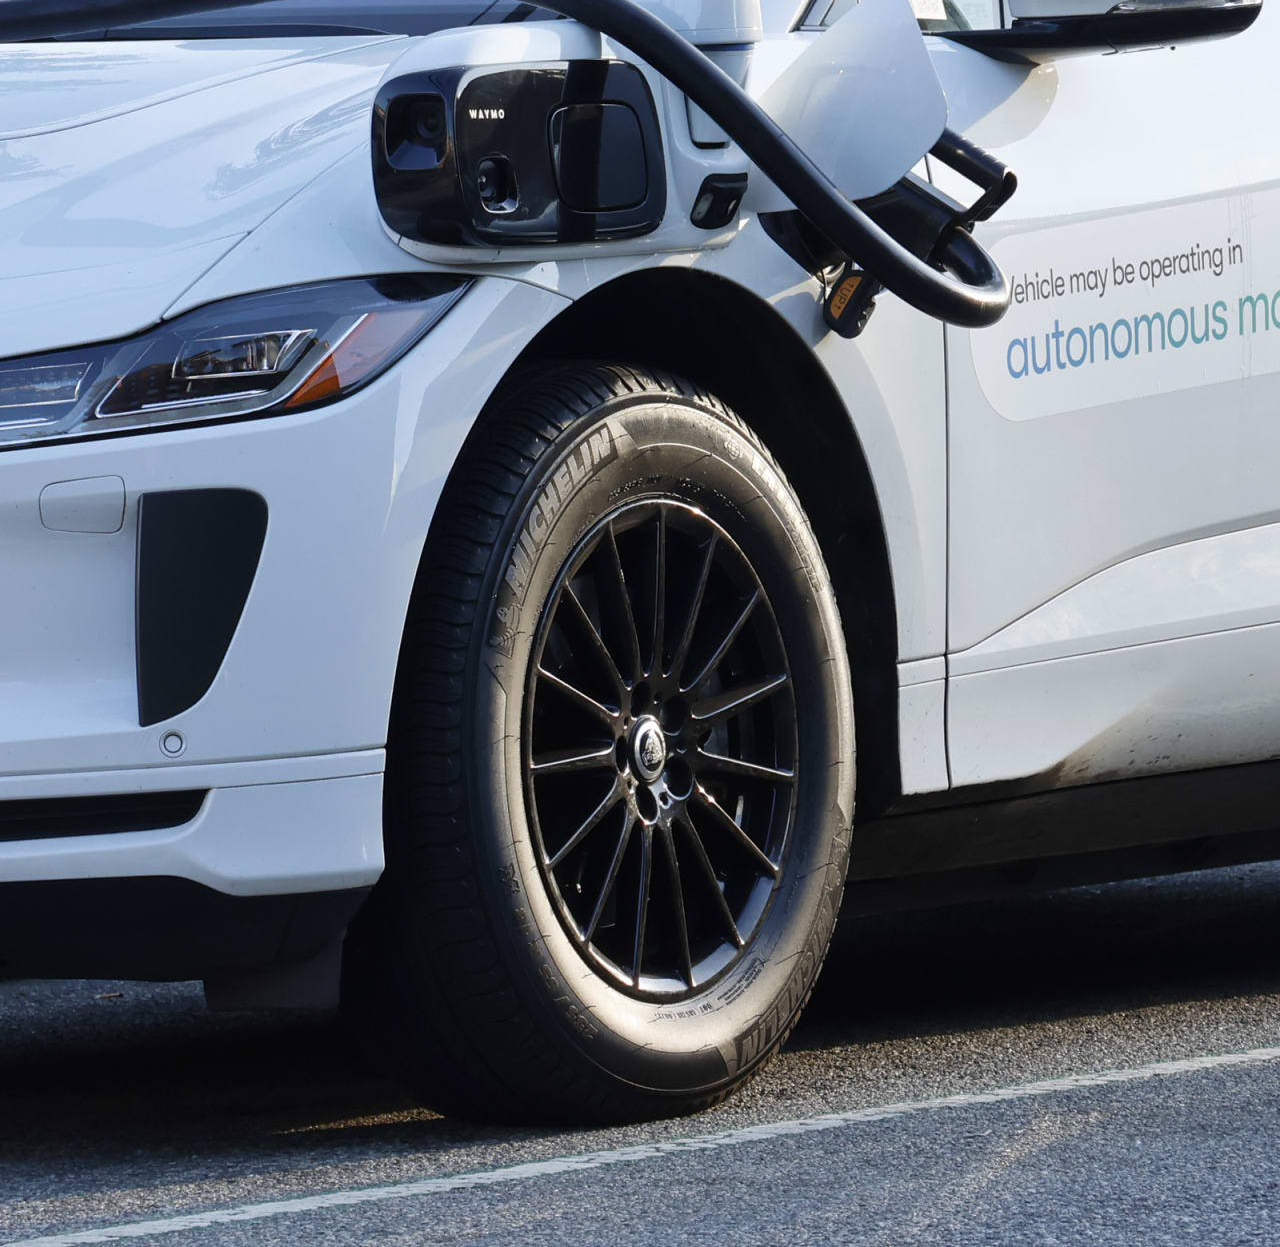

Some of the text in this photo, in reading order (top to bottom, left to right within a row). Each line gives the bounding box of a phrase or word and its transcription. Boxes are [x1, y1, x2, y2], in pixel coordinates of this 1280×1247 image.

[468, 109, 505, 119] WAYMO
[1070, 267, 1109, 298] may
[1112, 257, 1136, 286] be
[1139, 242, 1224, 288] operating
[1228, 237, 1243, 265] in
[1007, 299, 1229, 379] autonomous
[504, 426, 613, 600] MICHELIN
